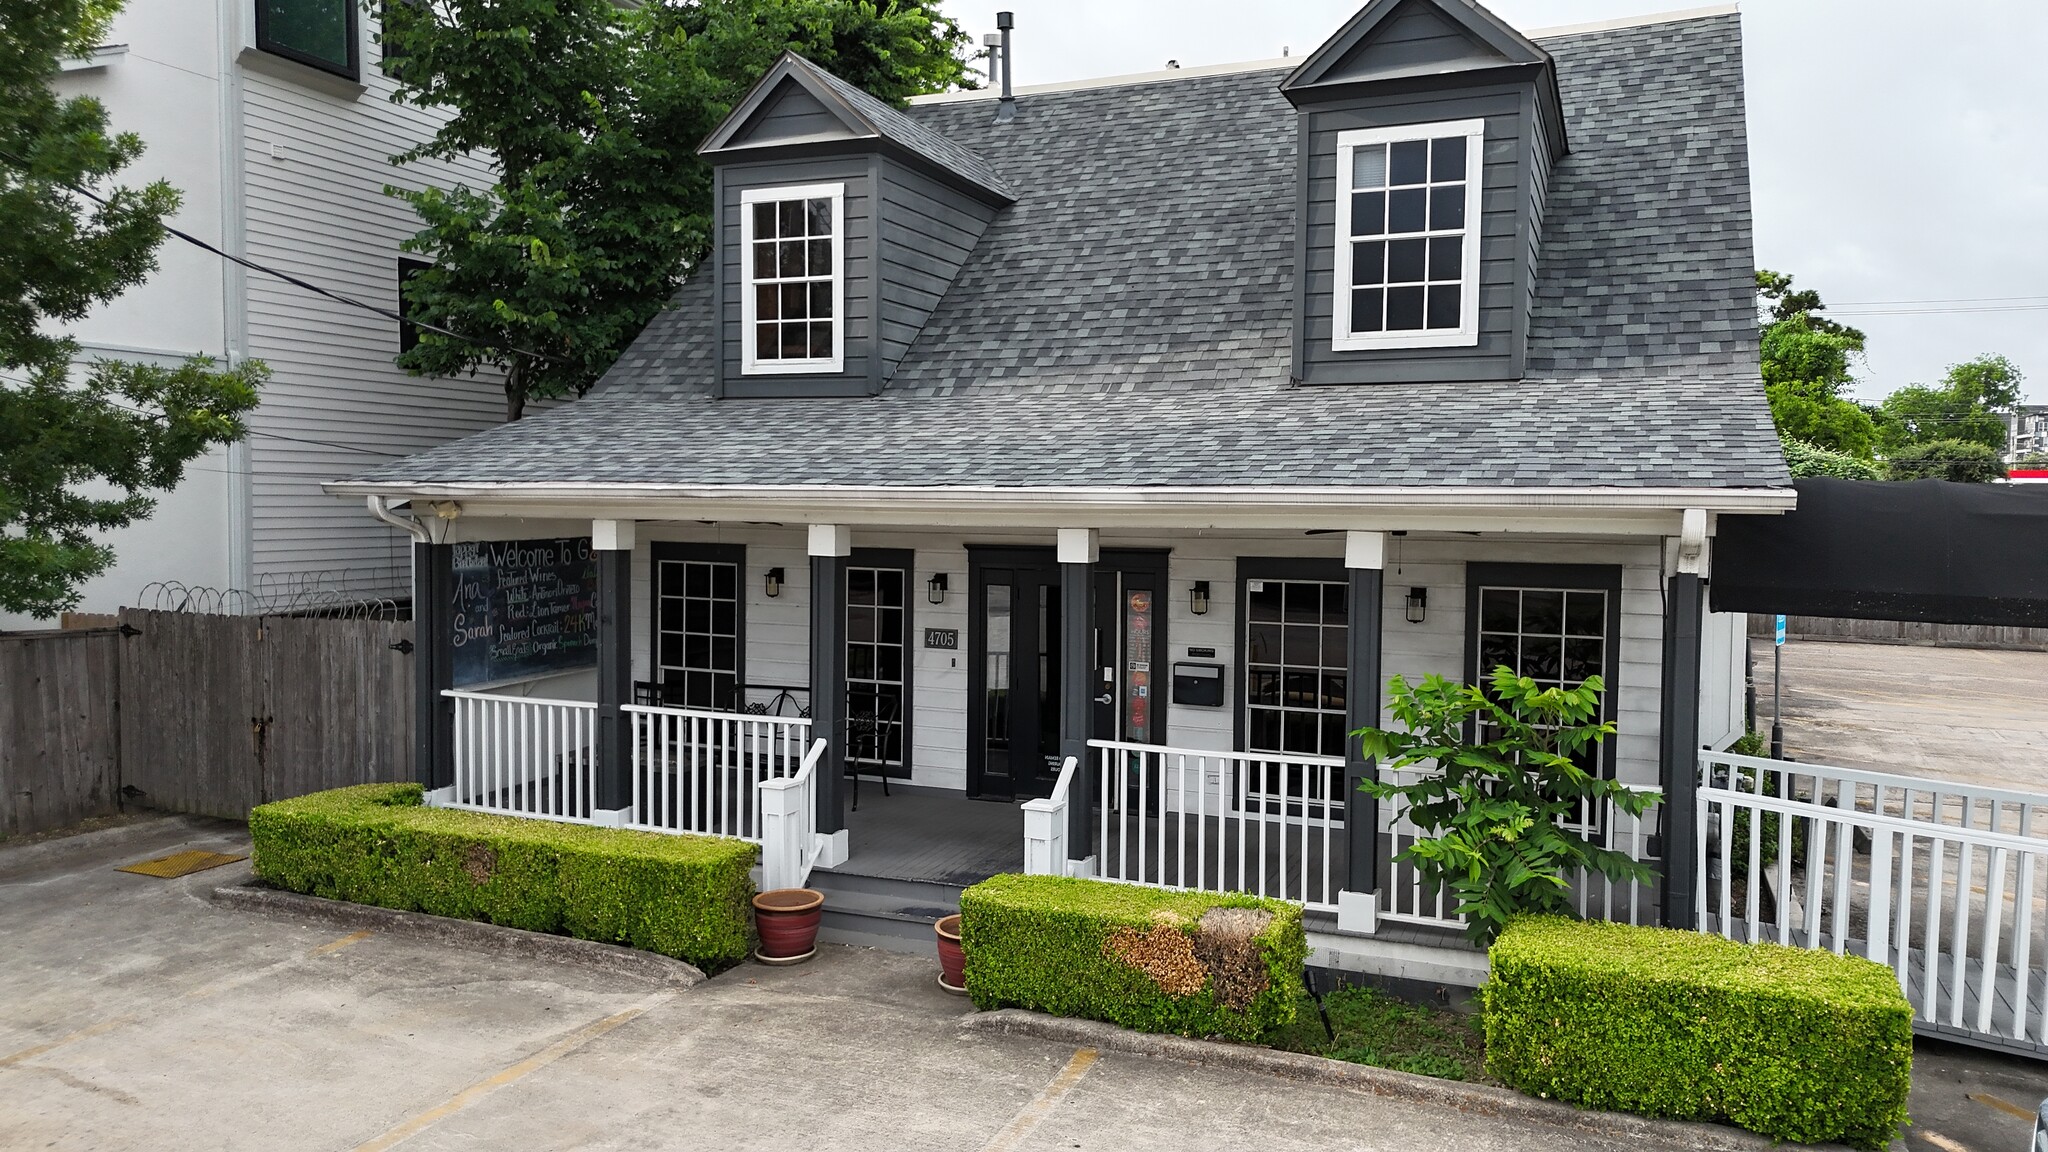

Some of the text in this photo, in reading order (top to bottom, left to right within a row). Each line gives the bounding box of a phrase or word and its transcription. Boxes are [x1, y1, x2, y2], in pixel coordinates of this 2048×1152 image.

[490, 541, 554, 567] Welcome
[555, 540, 571, 566] To
[528, 567, 557, 583] Wines
[453, 572, 486, 613] Ana
[475, 597, 488, 612] and
[529, 601, 550, 618] Lion
[453, 613, 493, 647] Sarah
[927, 631, 954, 646] 4705
[532, 640, 558, 655] Organic
